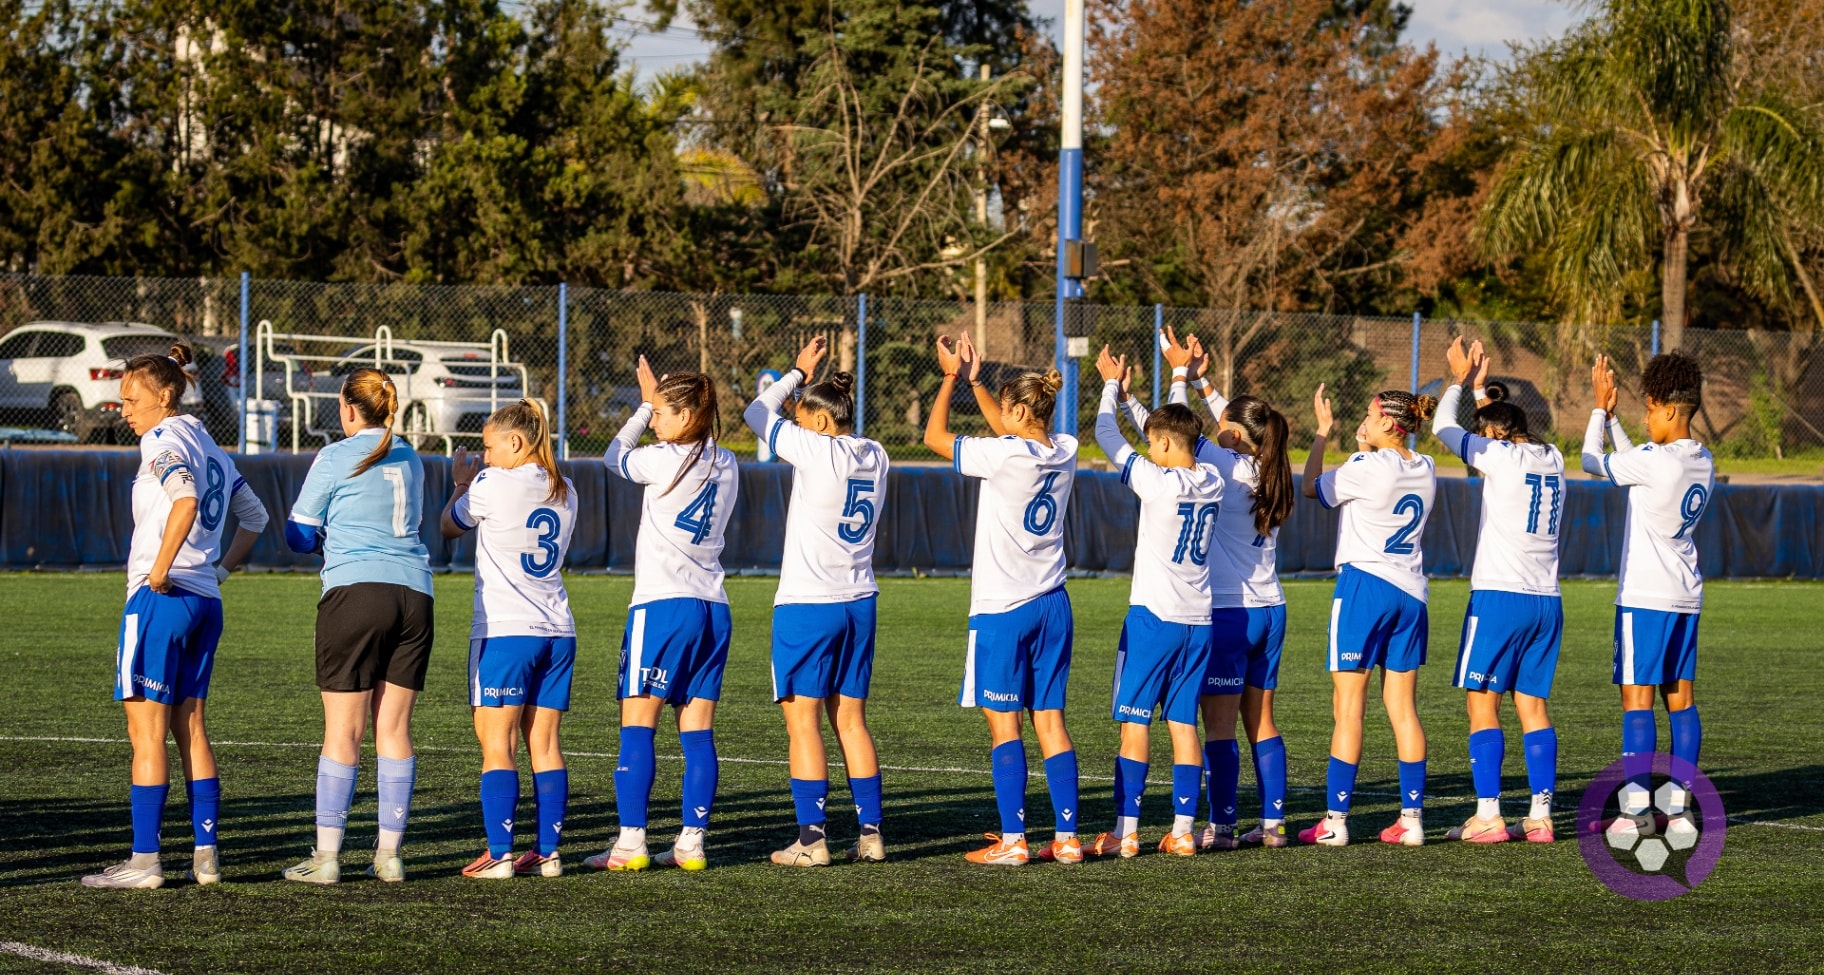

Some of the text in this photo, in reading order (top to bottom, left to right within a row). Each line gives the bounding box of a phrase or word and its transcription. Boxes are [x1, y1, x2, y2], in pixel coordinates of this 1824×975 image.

[199, 456, 225, 531] 8
[382, 467, 408, 538] 1
[674, 481, 718, 546] 4
[837, 478, 875, 544] 5
[1023, 471, 1057, 537] 6
[1384, 493, 1424, 555] 2
[1525, 473, 1560, 535] 11
[1672, 483, 1708, 539] 9
[520, 507, 561, 578] 3
[1171, 502, 1219, 566] 10
[484, 687, 524, 699] PRIMICIA
[640, 667, 668, 684] TDL
[983, 689, 1019, 702] PRIMICIA
[1119, 704, 1151, 719] PRMICI
